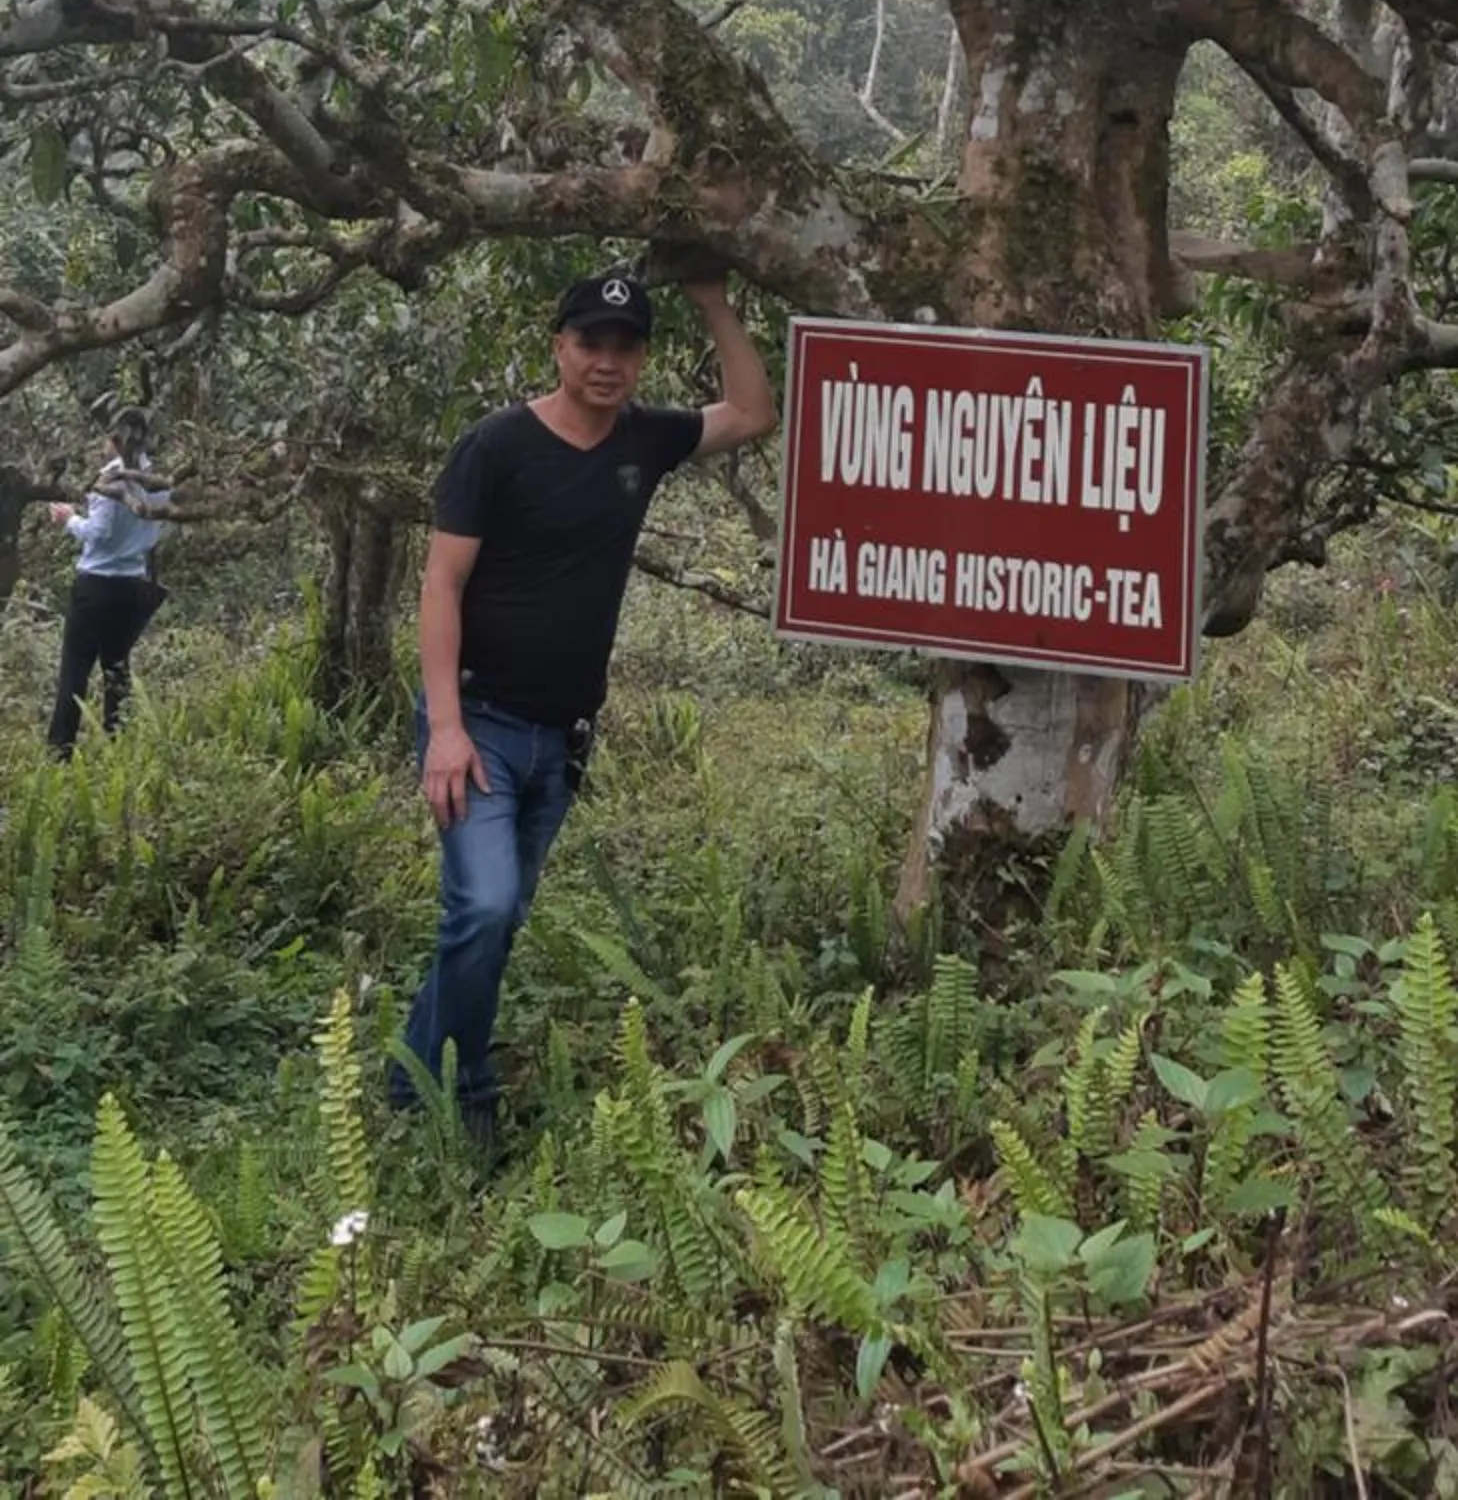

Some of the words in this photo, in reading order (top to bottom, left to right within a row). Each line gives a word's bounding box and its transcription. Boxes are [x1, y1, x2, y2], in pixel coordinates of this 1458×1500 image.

[820, 361, 914, 490] VÙNG
[922, 376, 1072, 506] NGUYÊN
[1081, 384, 1166, 532] LIỆU
[808, 528, 848, 594] HÀ
[857, 542, 947, 605] GIANG
[954, 552, 1162, 629] HISTORIC-TEA
